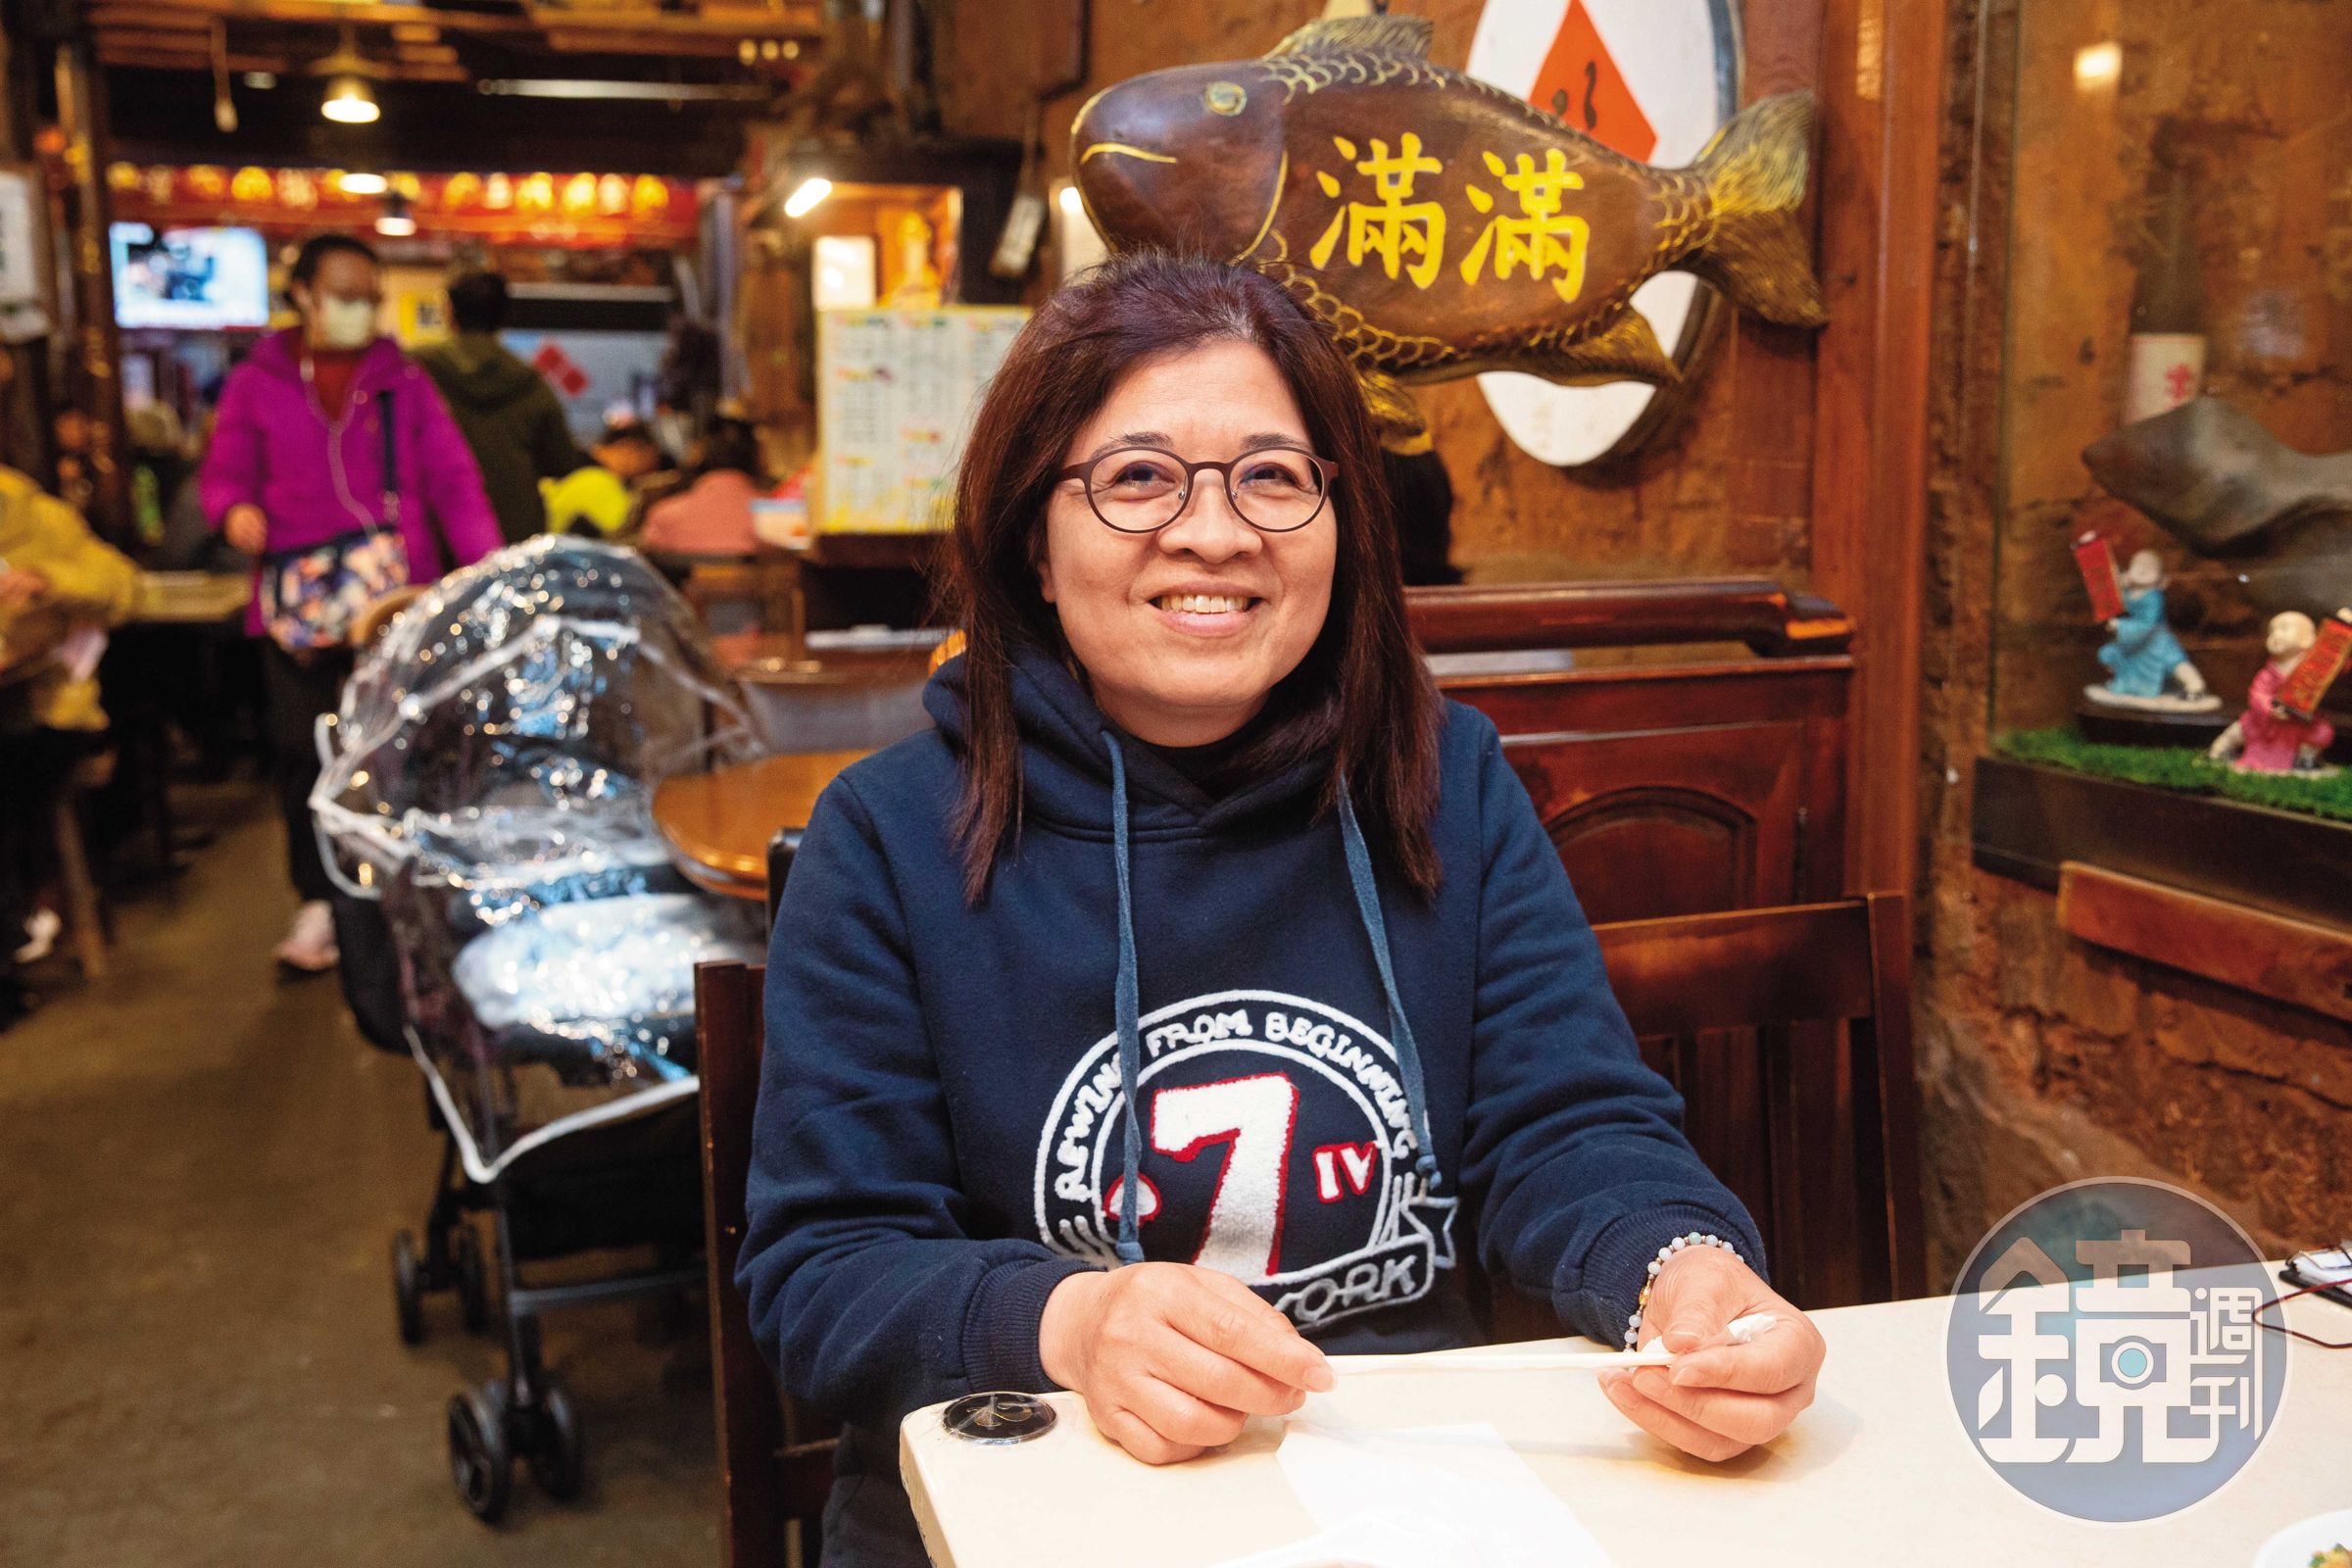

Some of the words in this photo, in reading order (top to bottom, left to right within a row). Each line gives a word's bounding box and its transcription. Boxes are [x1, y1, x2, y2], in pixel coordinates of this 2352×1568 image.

[1309, 131, 1591, 304] 滿滿
[1146, 1008, 1252, 1058] FROM
[1151, 1072, 1299, 1280] 7
